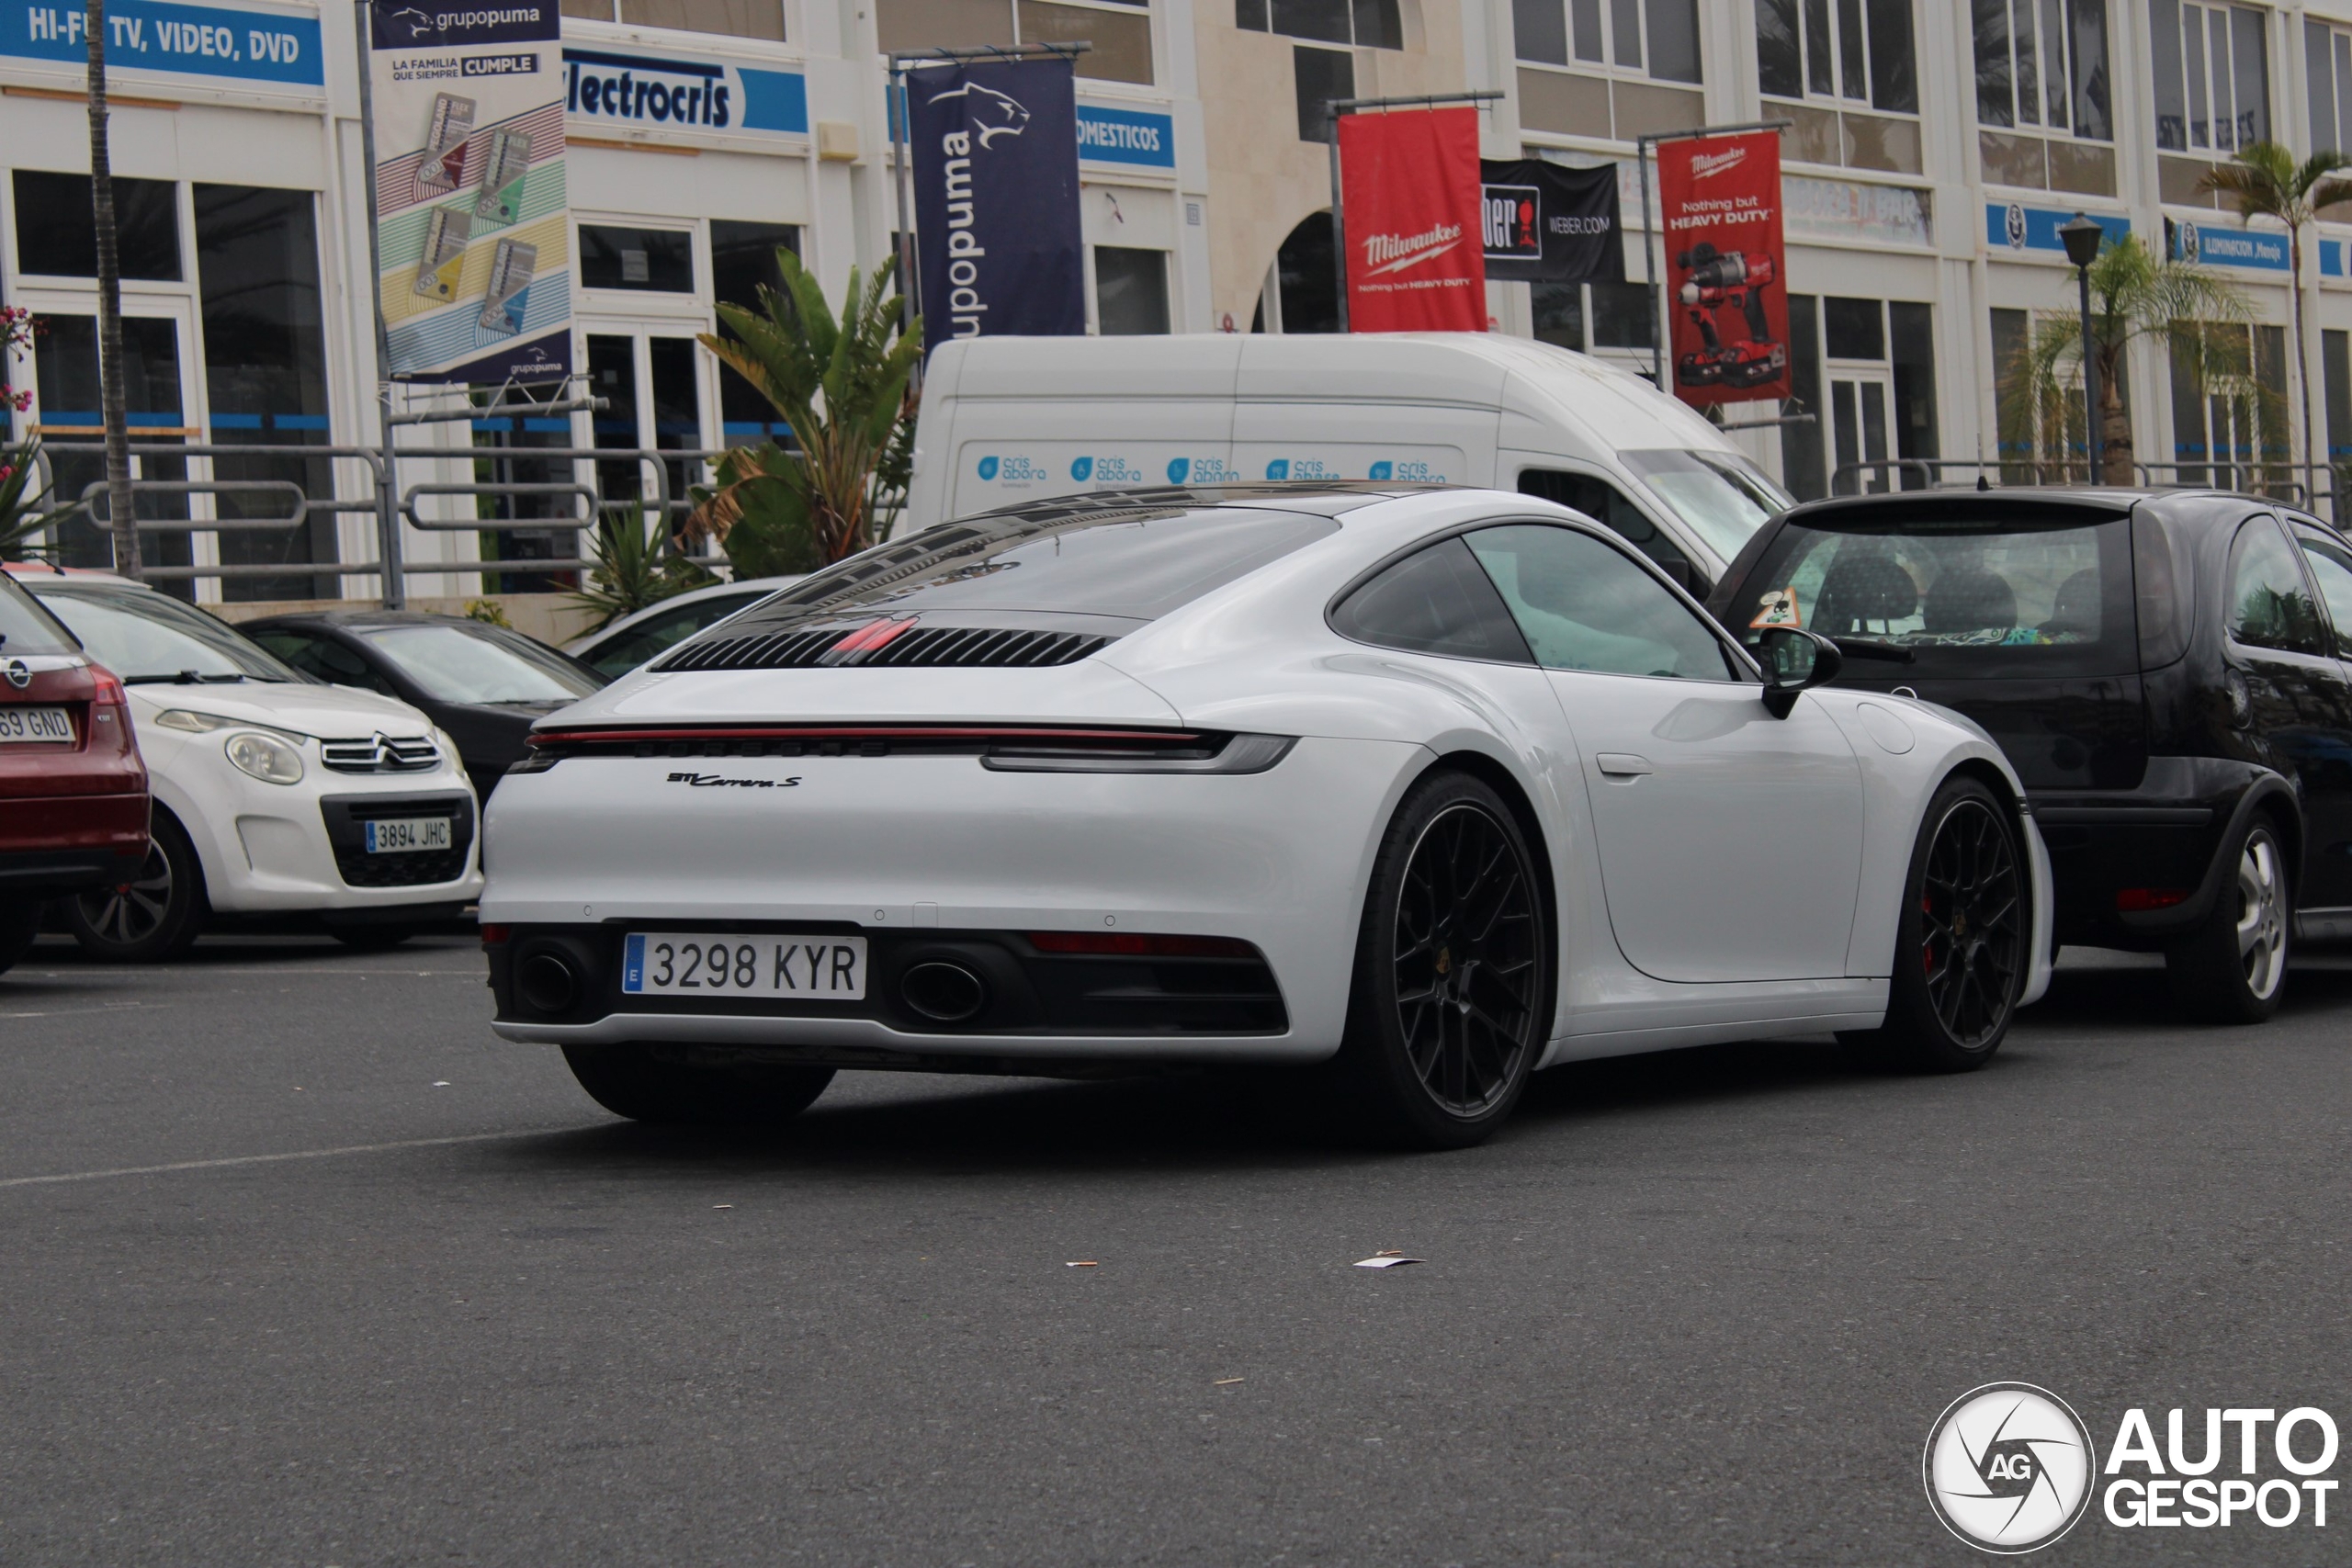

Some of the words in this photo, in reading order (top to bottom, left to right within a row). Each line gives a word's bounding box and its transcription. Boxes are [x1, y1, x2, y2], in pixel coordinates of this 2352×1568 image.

[436, 8, 540, 31] grupopuma
[108, 16, 147, 52] TV,
[156, 20, 240, 62] VIDEO,
[249, 29, 300, 63] DVD
[393, 61, 406, 70] LA
[412, 58, 458, 69] FAMILIA
[465, 57, 531, 74] CUMPLE
[393, 71, 413, 81] QUE
[416, 70, 459, 80] SIEMPRE
[429, 98, 447, 151] PEGOLAND
[1690, 147, 1746, 174] Milwaukee
[1682, 199, 1733, 213] Nothing
[1736, 196, 1758, 208] but
[1549, 216, 1610, 235] WEBER.COM
[1670, 214, 1722, 230] HEAVY
[1361, 222, 1462, 266] Milwaukee
[1358, 284, 1393, 293] Nothing
[1394, 281, 1408, 291] but
[1409, 279, 1442, 289] HEAVY
[511, 362, 562, 374] grupopuma
[1002, 455, 1030, 468] cris
[1097, 455, 1125, 469] cris
[1194, 457, 1223, 470] cris
[1295, 458, 1323, 473] cris
[1398, 459, 1428, 474] cris
[1001, 468, 1046, 480] abora
[1096, 469, 1141, 482] abora
[28, 711, 69, 737] GND
[691, 775, 775, 787] Carrera
[777, 777, 802, 787] S
[379, 824, 415, 848] 3894
[422, 822, 447, 845] JHC
[628, 969, 639, 982] E
[652, 942, 756, 988] 3298
[774, 944, 855, 991] KYR
